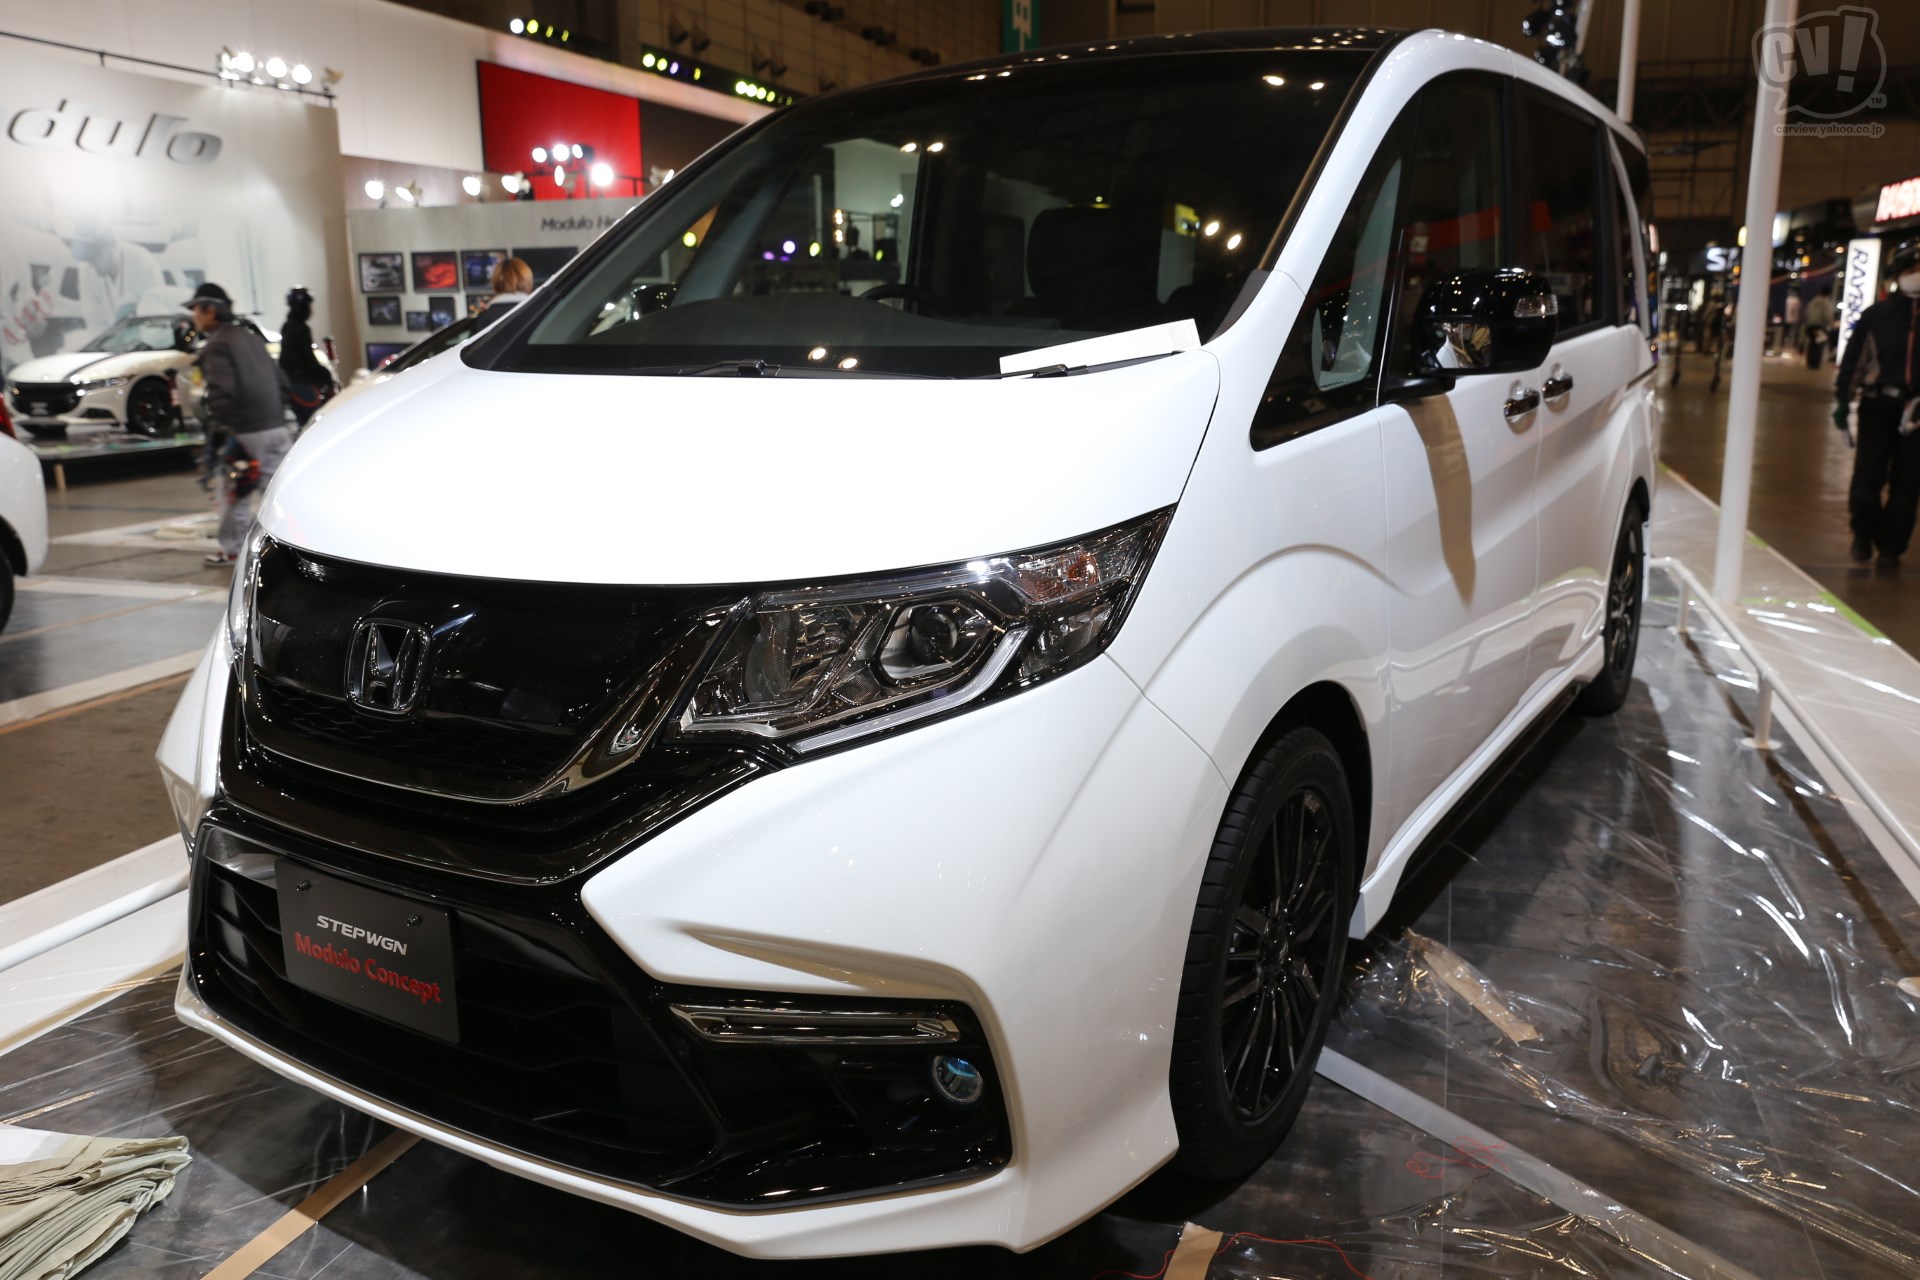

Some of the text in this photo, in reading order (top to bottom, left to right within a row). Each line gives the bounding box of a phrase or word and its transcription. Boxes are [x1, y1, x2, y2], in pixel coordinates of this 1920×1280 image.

[541, 217, 594, 231] Modulo
[316, 915, 408, 956] STEPWGN
[294, 931, 442, 1004] Modulo Concept
